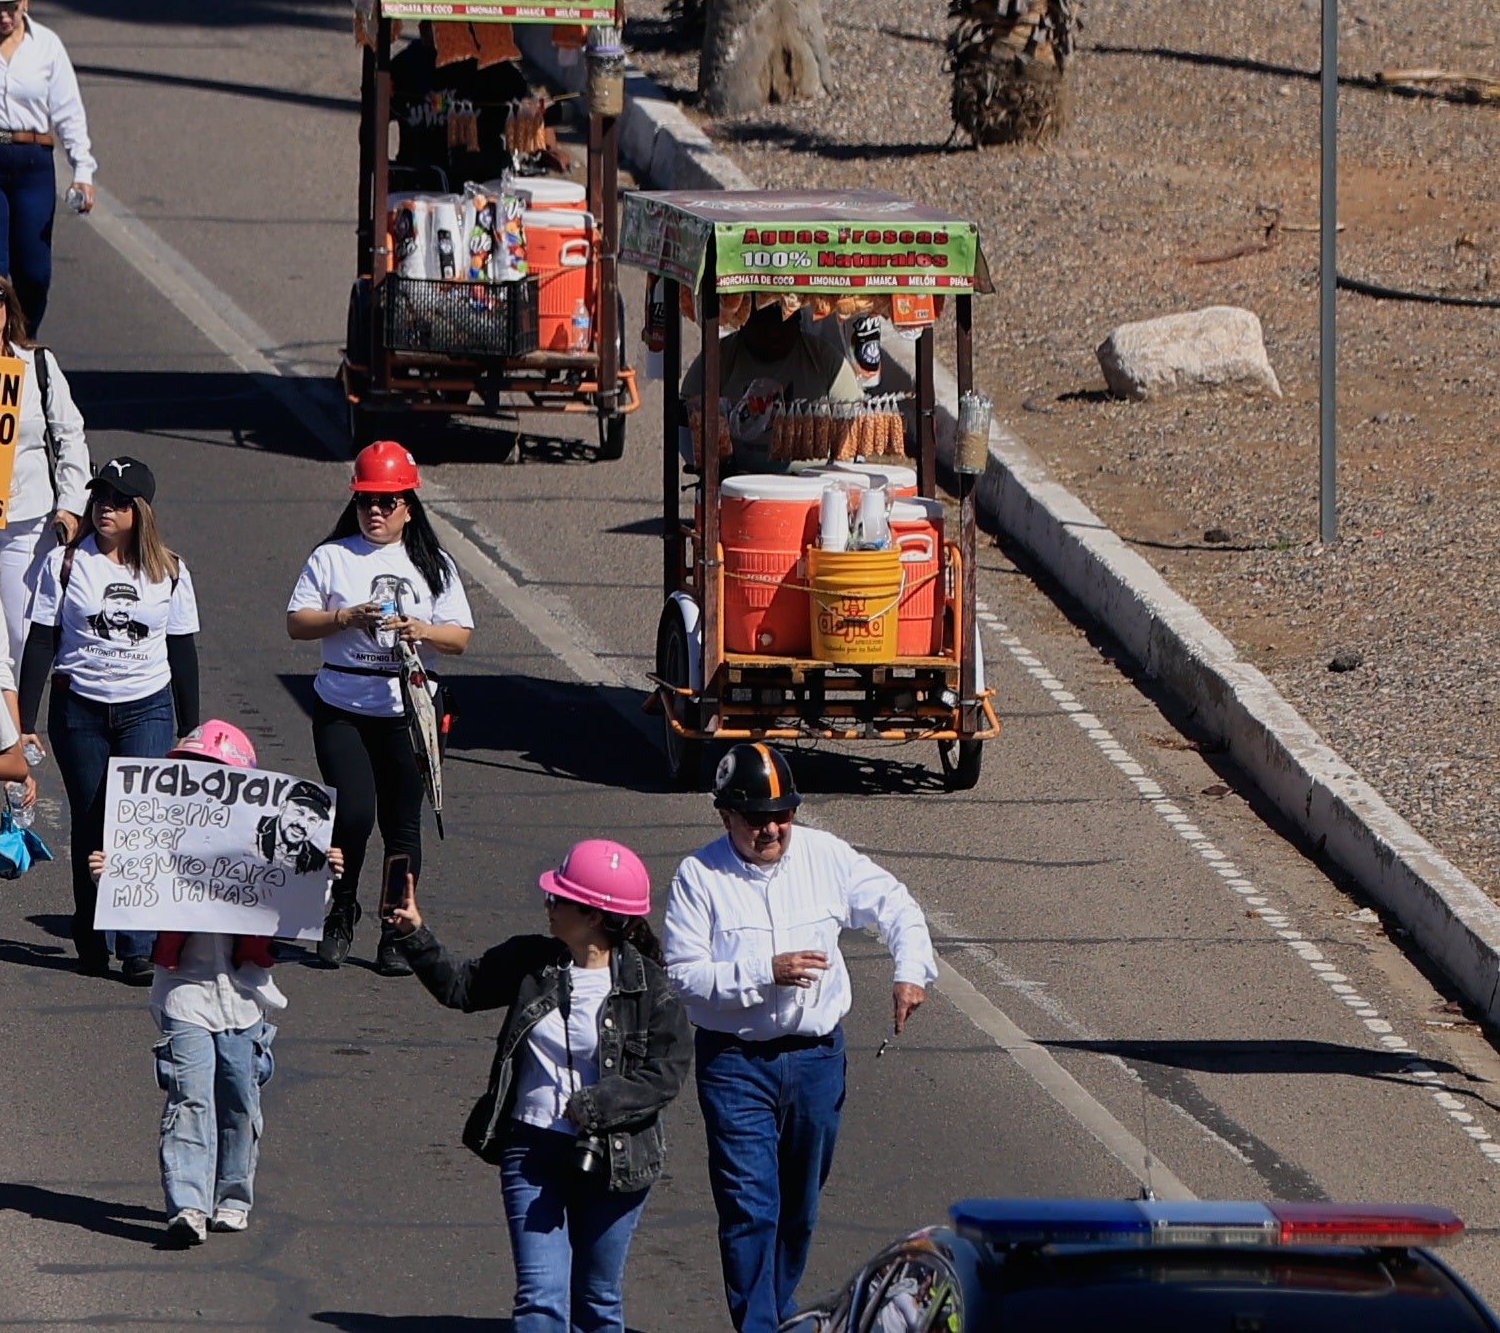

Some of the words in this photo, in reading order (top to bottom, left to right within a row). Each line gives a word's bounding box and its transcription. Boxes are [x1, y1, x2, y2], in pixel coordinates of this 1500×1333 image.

[742, 228, 829, 245] Aguas
[838, 227, 949, 245] Frescas
[740, 250, 812, 268] 100%
[817, 250, 949, 268] Naturales
[719, 274, 759, 286] HORCHATA
[761, 275, 771, 285] DE
[773, 275, 795, 285] COCO
[809, 275, 851, 287] LIMONADA
[865, 275, 898, 286] JAMAICA
[909, 274, 936, 286] MELÓN
